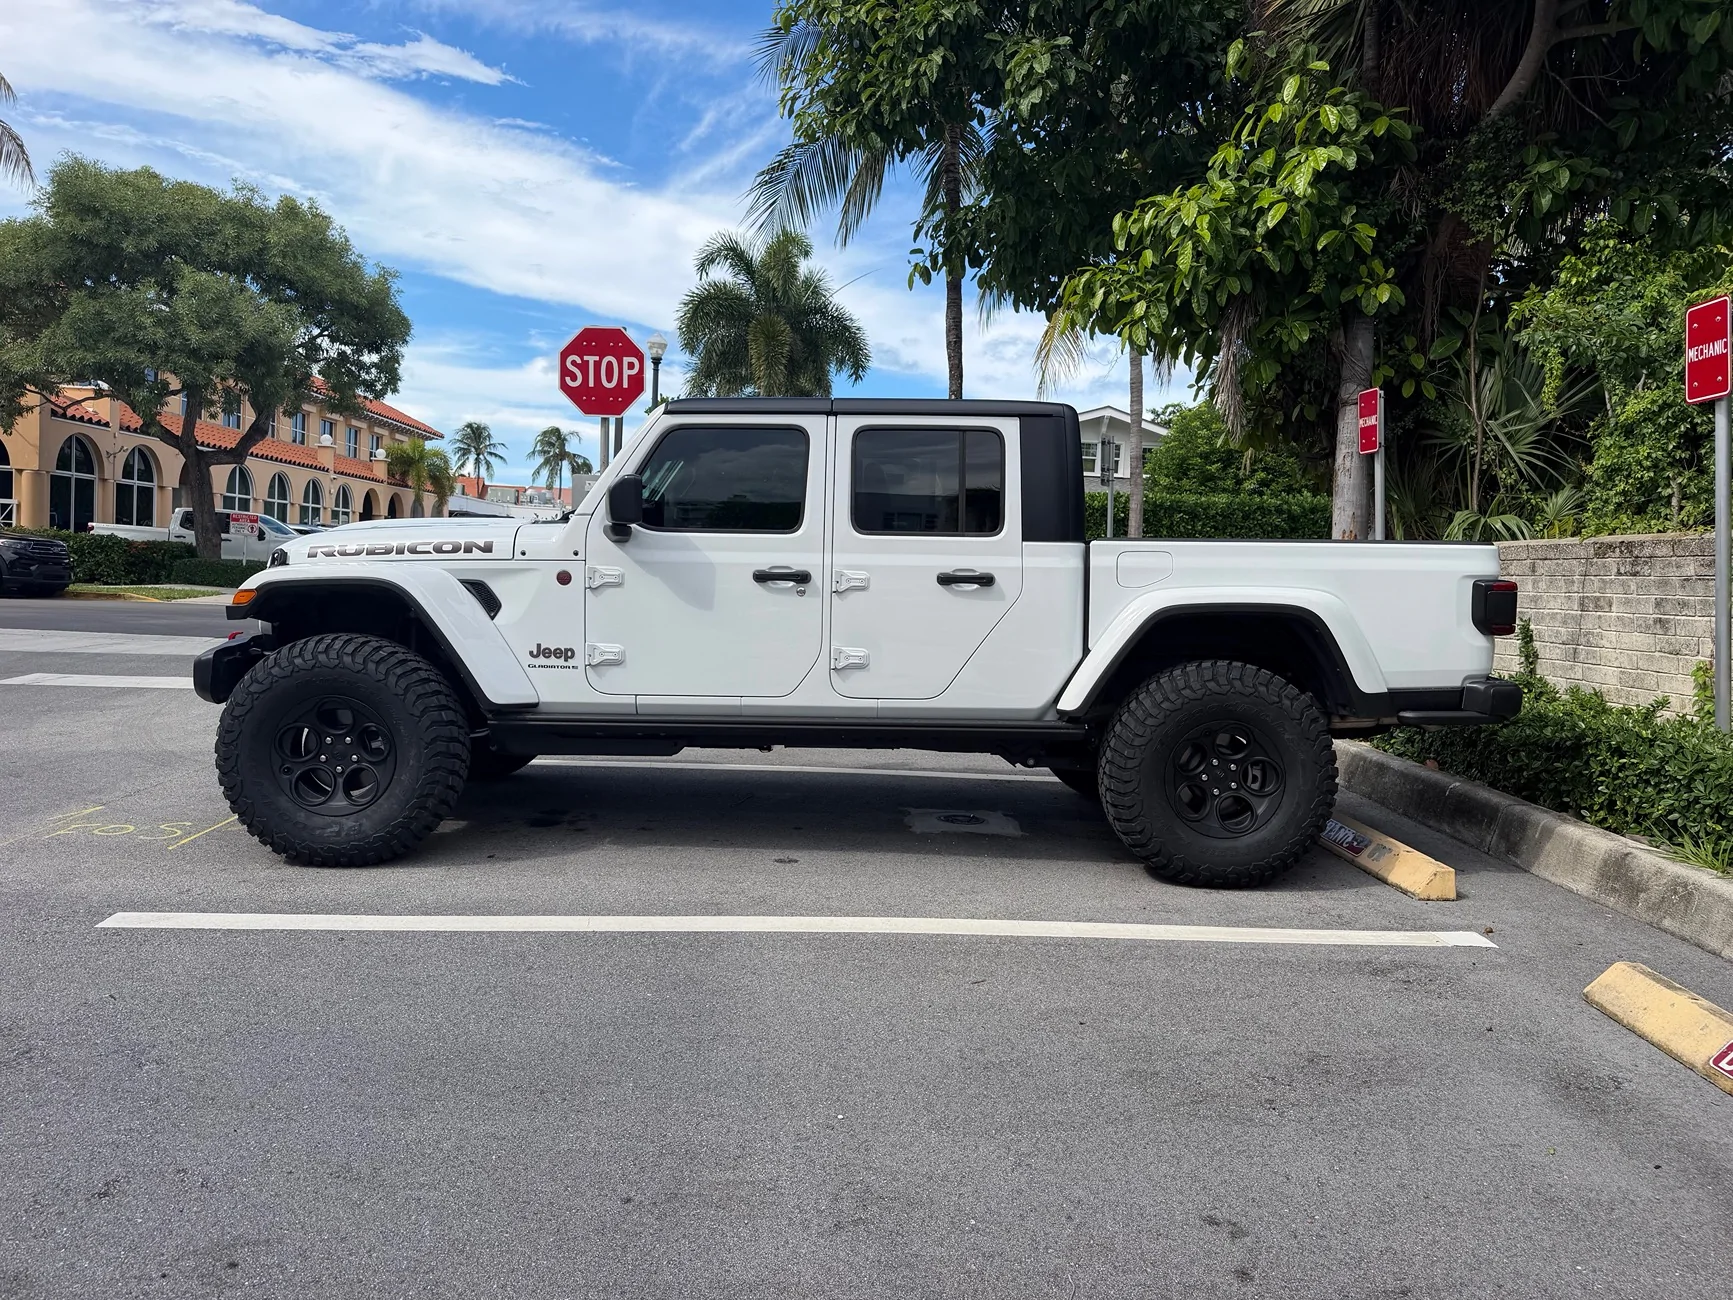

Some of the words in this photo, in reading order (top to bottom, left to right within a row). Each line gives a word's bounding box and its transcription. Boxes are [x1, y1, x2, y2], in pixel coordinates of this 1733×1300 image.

[1688, 338, 1727, 363] MECHANIC
[565, 354, 640, 389] STOP
[1360, 415, 1378, 427] MECHANIC
[307, 541, 494, 558] RUBICON
[529, 643, 575, 662] Jeep
